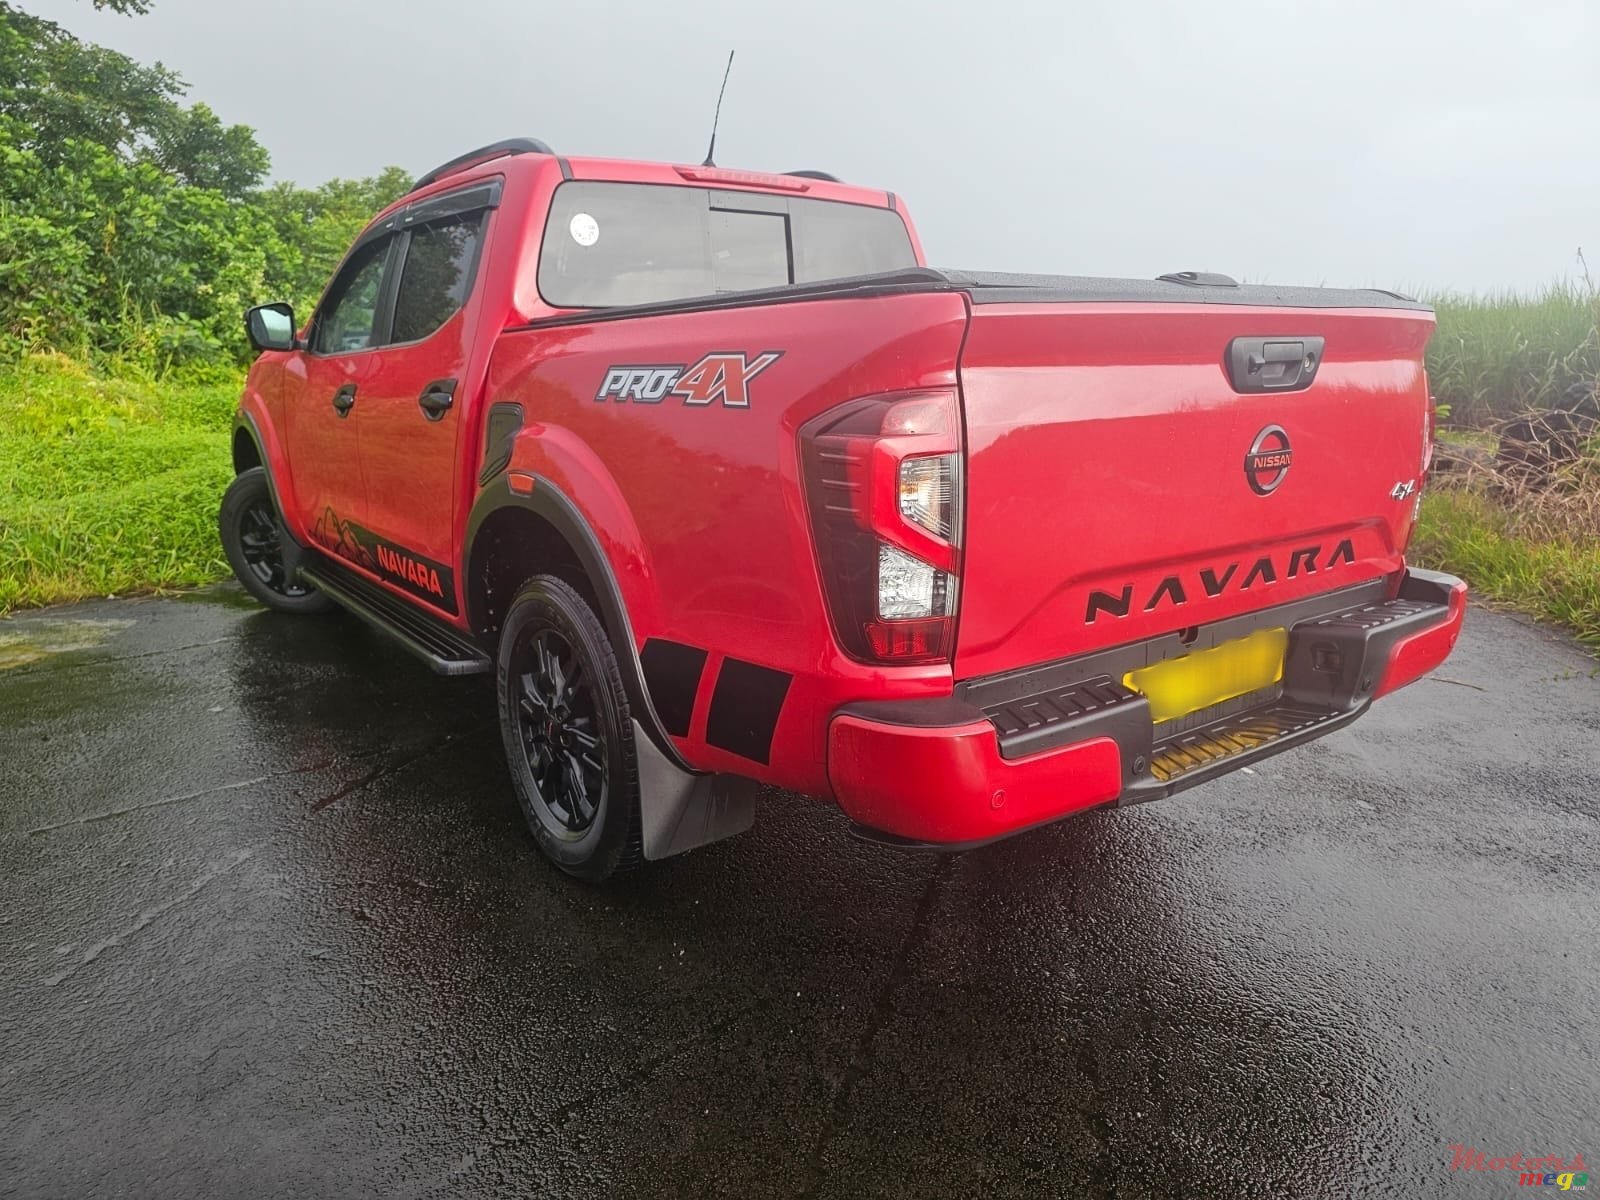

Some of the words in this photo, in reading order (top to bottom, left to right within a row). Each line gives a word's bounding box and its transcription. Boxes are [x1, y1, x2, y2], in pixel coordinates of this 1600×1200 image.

[595, 350, 786, 408] PRO-4X
[1253, 454, 1291, 469] NISSAN
[376, 544, 443, 597] NAVARA
[1085, 538, 1355, 625] NAVARA
